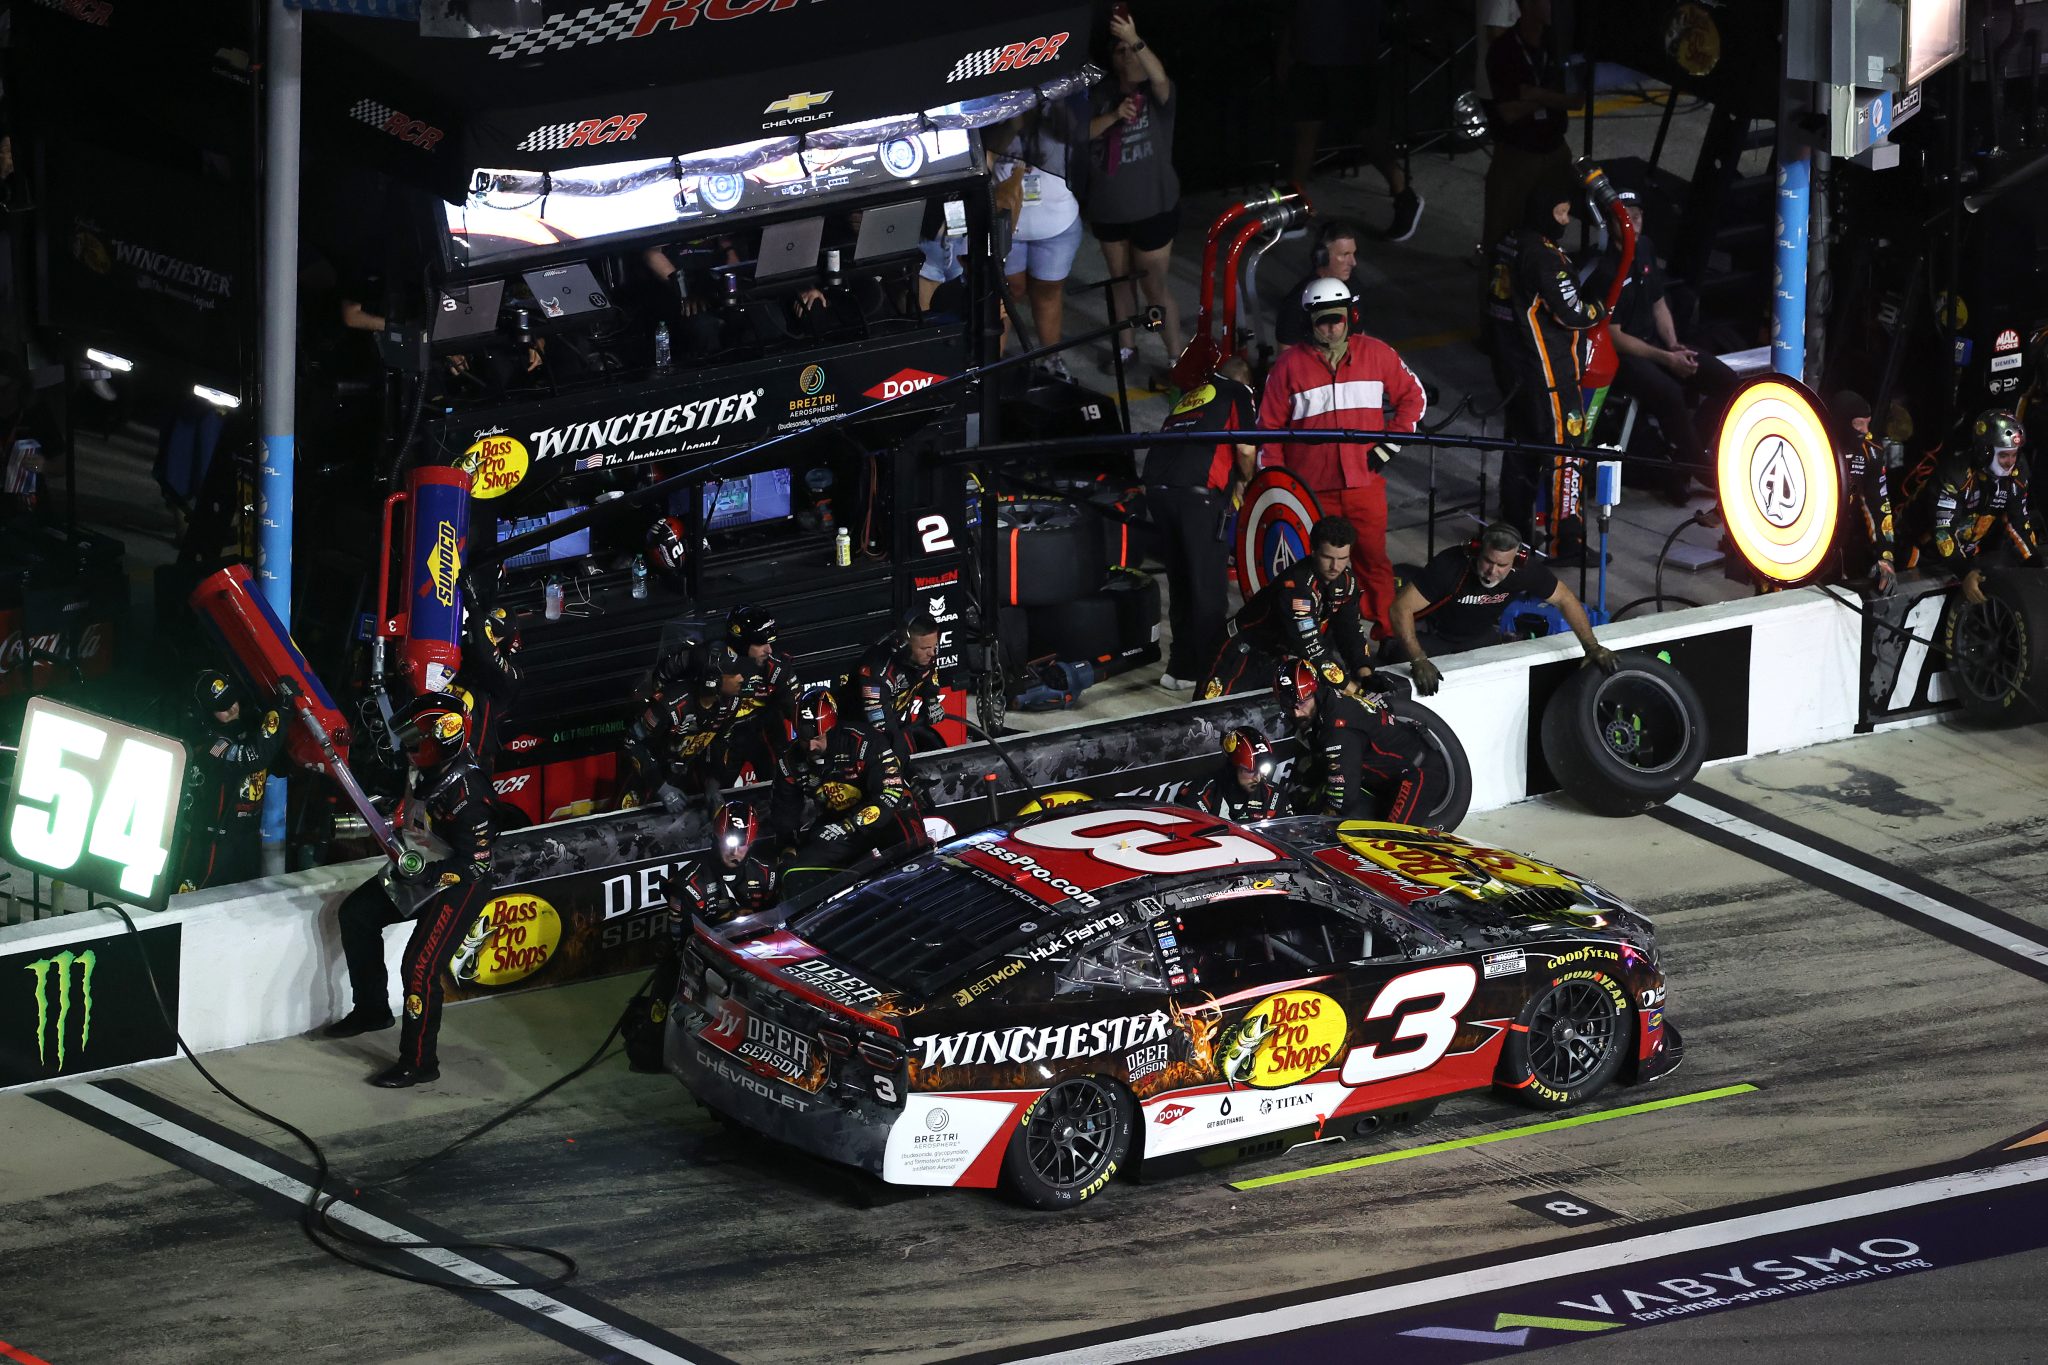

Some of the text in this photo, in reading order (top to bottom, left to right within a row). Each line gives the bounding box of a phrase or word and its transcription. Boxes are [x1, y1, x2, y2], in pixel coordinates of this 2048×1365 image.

[631, 0, 800, 37] RC
[989, 32, 1070, 74] RCR
[385, 110, 445, 150] RCR
[562, 112, 648, 150] RCR
[762, 111, 834, 130] CHEVROLET
[111, 239, 232, 298] WINCHESTER
[443, 298, 457, 311] 3
[1996, 342, 2018, 352] TOOLS
[789, 394, 837, 411] BREZTRI
[789, 403, 838, 419] AEROSPHERE
[1080, 404, 1102, 421] 19
[530, 388, 761, 463] WINCHESTER
[480, 440, 512, 459] Bass
[482, 469, 521, 490] Shops
[483, 457, 506, 476] Pro
[916, 515, 956, 553] 2
[438, 524, 456, 605] SUNOCO
[913, 569, 960, 588] WHELEN
[1279, 675, 1292, 686] 3
[802, 706, 814, 720] 3
[512, 738, 537, 750] DOW
[1254, 742, 1269, 753] 3
[10, 710, 174, 899] 54
[1012, 808, 1280, 874] 3
[971, 869, 1062, 917] CHEVROLET
[1182, 896, 1202, 904] KRISTI
[491, 900, 537, 926] Bass
[491, 924, 527, 949] Pro
[1028, 940, 1067, 962] Huk
[1064, 912, 1126, 945] Fishing
[490, 943, 549, 973] Shops
[1490, 960, 1521, 973] CUP SERIES
[1547, 945, 1619, 970] GOODYEAR
[782, 966, 859, 1008] SEASON
[797, 959, 883, 1002] DEER
[969, 959, 1027, 996] BETMGM
[1269, 997, 1322, 1026] Bass
[1339, 963, 1479, 1088] 3
[747, 1015, 811, 1071] DEER
[913, 1009, 1171, 1070] WINCHESTER
[1269, 1022, 1309, 1049] Pro
[738, 1042, 805, 1081] SEASON
[1126, 1043, 1168, 1072] DEER
[1128, 1060, 1168, 1083] SEASON
[1267, 1043, 1331, 1074] Shops
[696, 1050, 810, 1113] CHEVROLET
[873, 1074, 897, 1103] 3
[1531, 1080, 1568, 1102] EAGLE
[1159, 1107, 1186, 1124] DOW
[1276, 1093, 1314, 1110] TITAN
[1206, 1115, 1245, 1129] GET BIOETHANOL
[914, 1133, 959, 1144] BREZTRI
[1079, 1161, 1118, 1201] EAGLE
[1544, 1199, 1589, 1218] 8
[1557, 1237, 1921, 1316] VABYSMO
[1630, 1256, 1935, 1323] faricimab-svoa injection 6 mg
